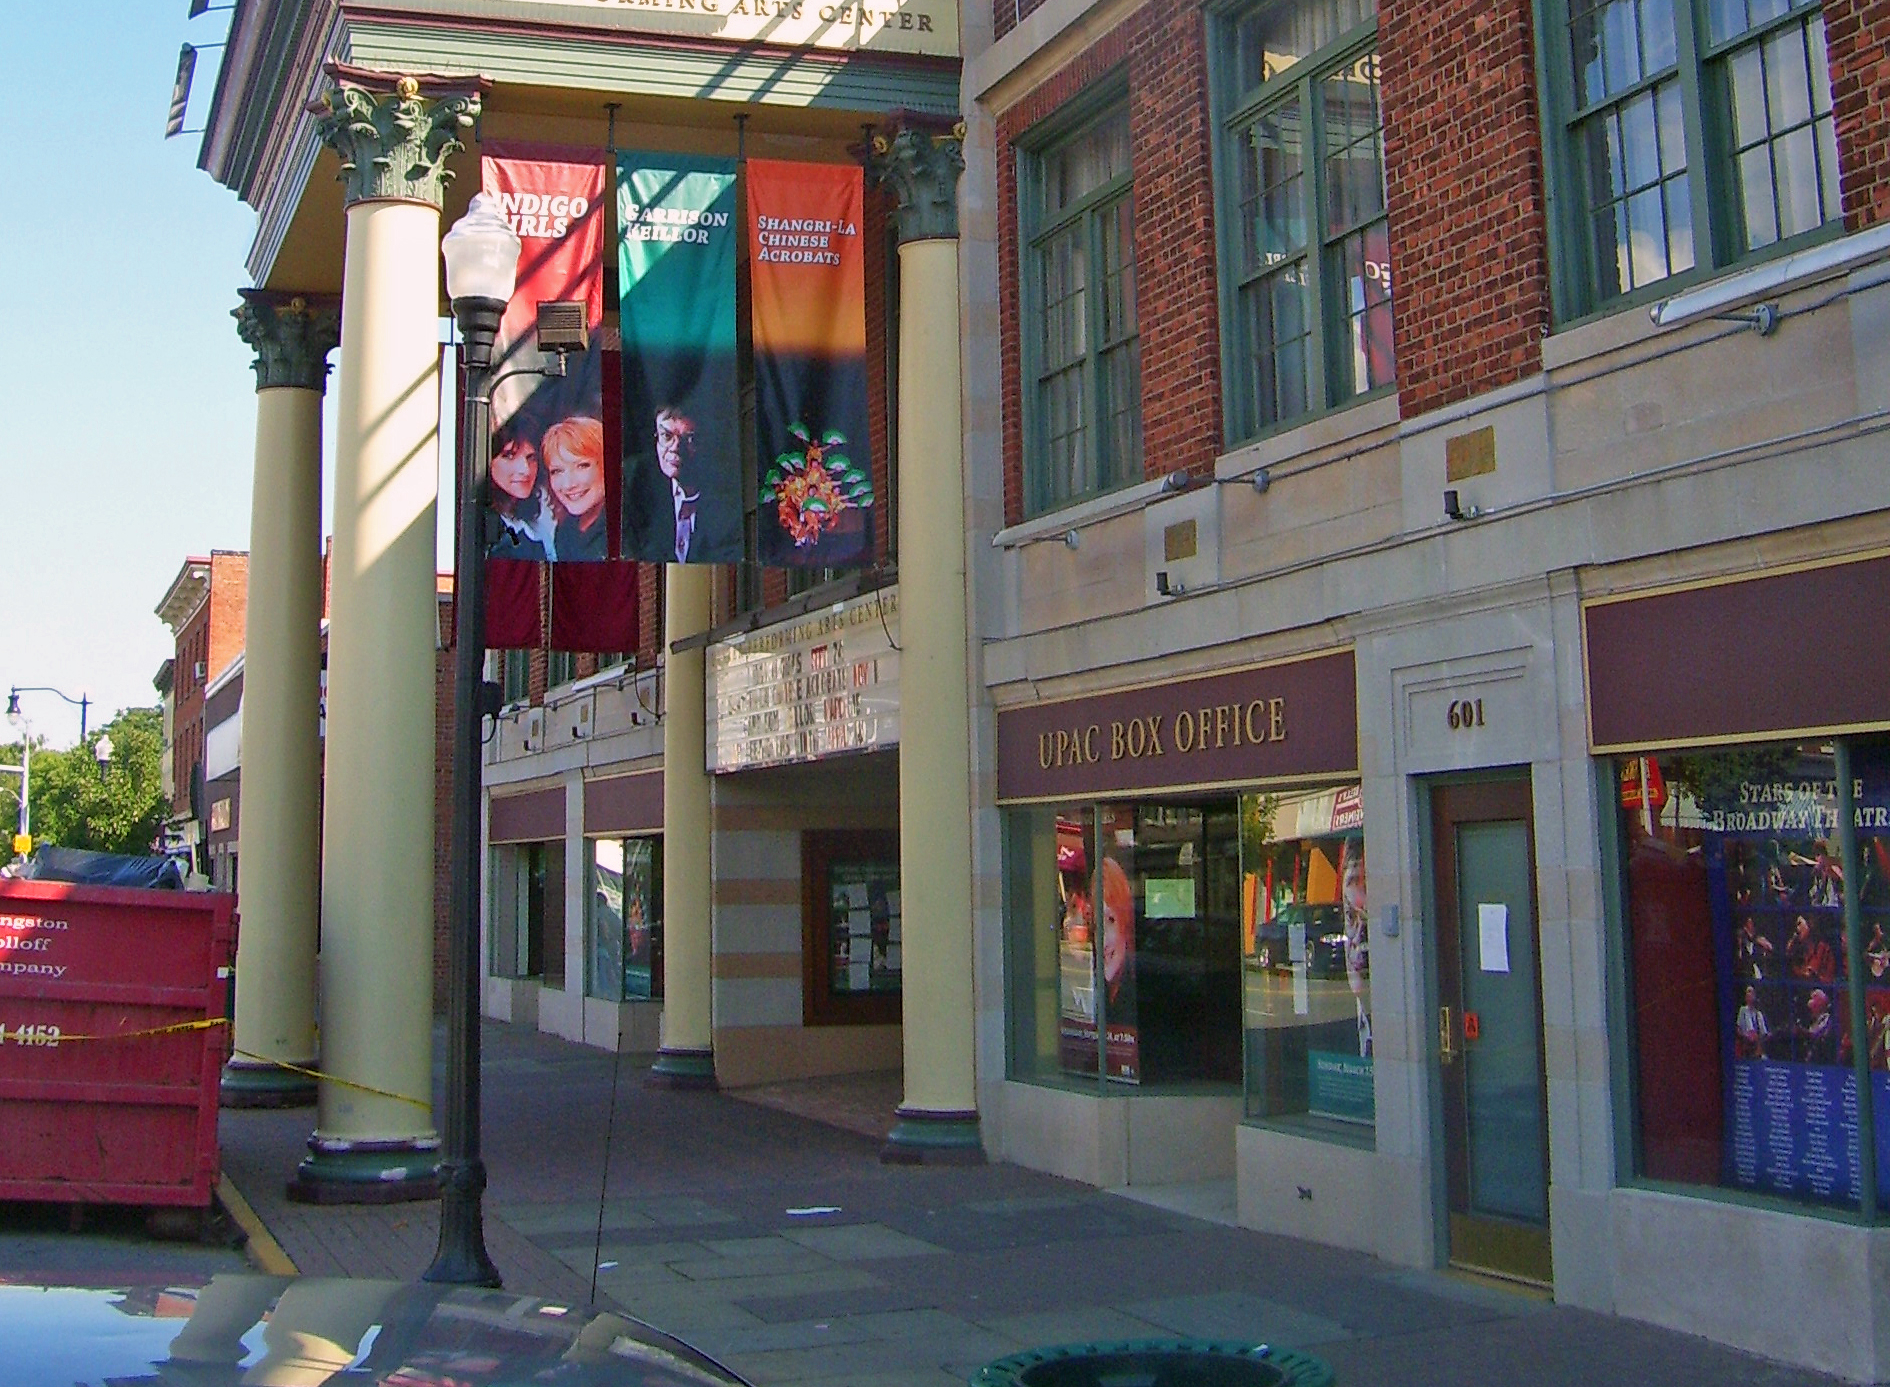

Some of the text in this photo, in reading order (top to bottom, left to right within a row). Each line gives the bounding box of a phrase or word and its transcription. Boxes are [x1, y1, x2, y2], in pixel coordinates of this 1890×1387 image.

[734, 0, 803, 19] ARTS
[819, 5, 934, 33] CENTER
[495, 193, 589, 218] NDIGO
[625, 203, 729, 226] GARRISON
[503, 214, 568, 238] IRLS
[625, 222, 709, 245] KEILLOR
[758, 215, 857, 235] SHANGRI-LA
[758, 231, 829, 247] CHINESE
[758, 247, 840, 266] ACROBATS
[849, 594, 898, 626] CENTER
[1447, 698, 1485, 729] 601
[1039, 697, 1286, 770] UPAC BOX OFFICE
[1739, 779, 1863, 803] STARS OF TE
[1712, 805, 1890, 832] BROADWAY THATR
